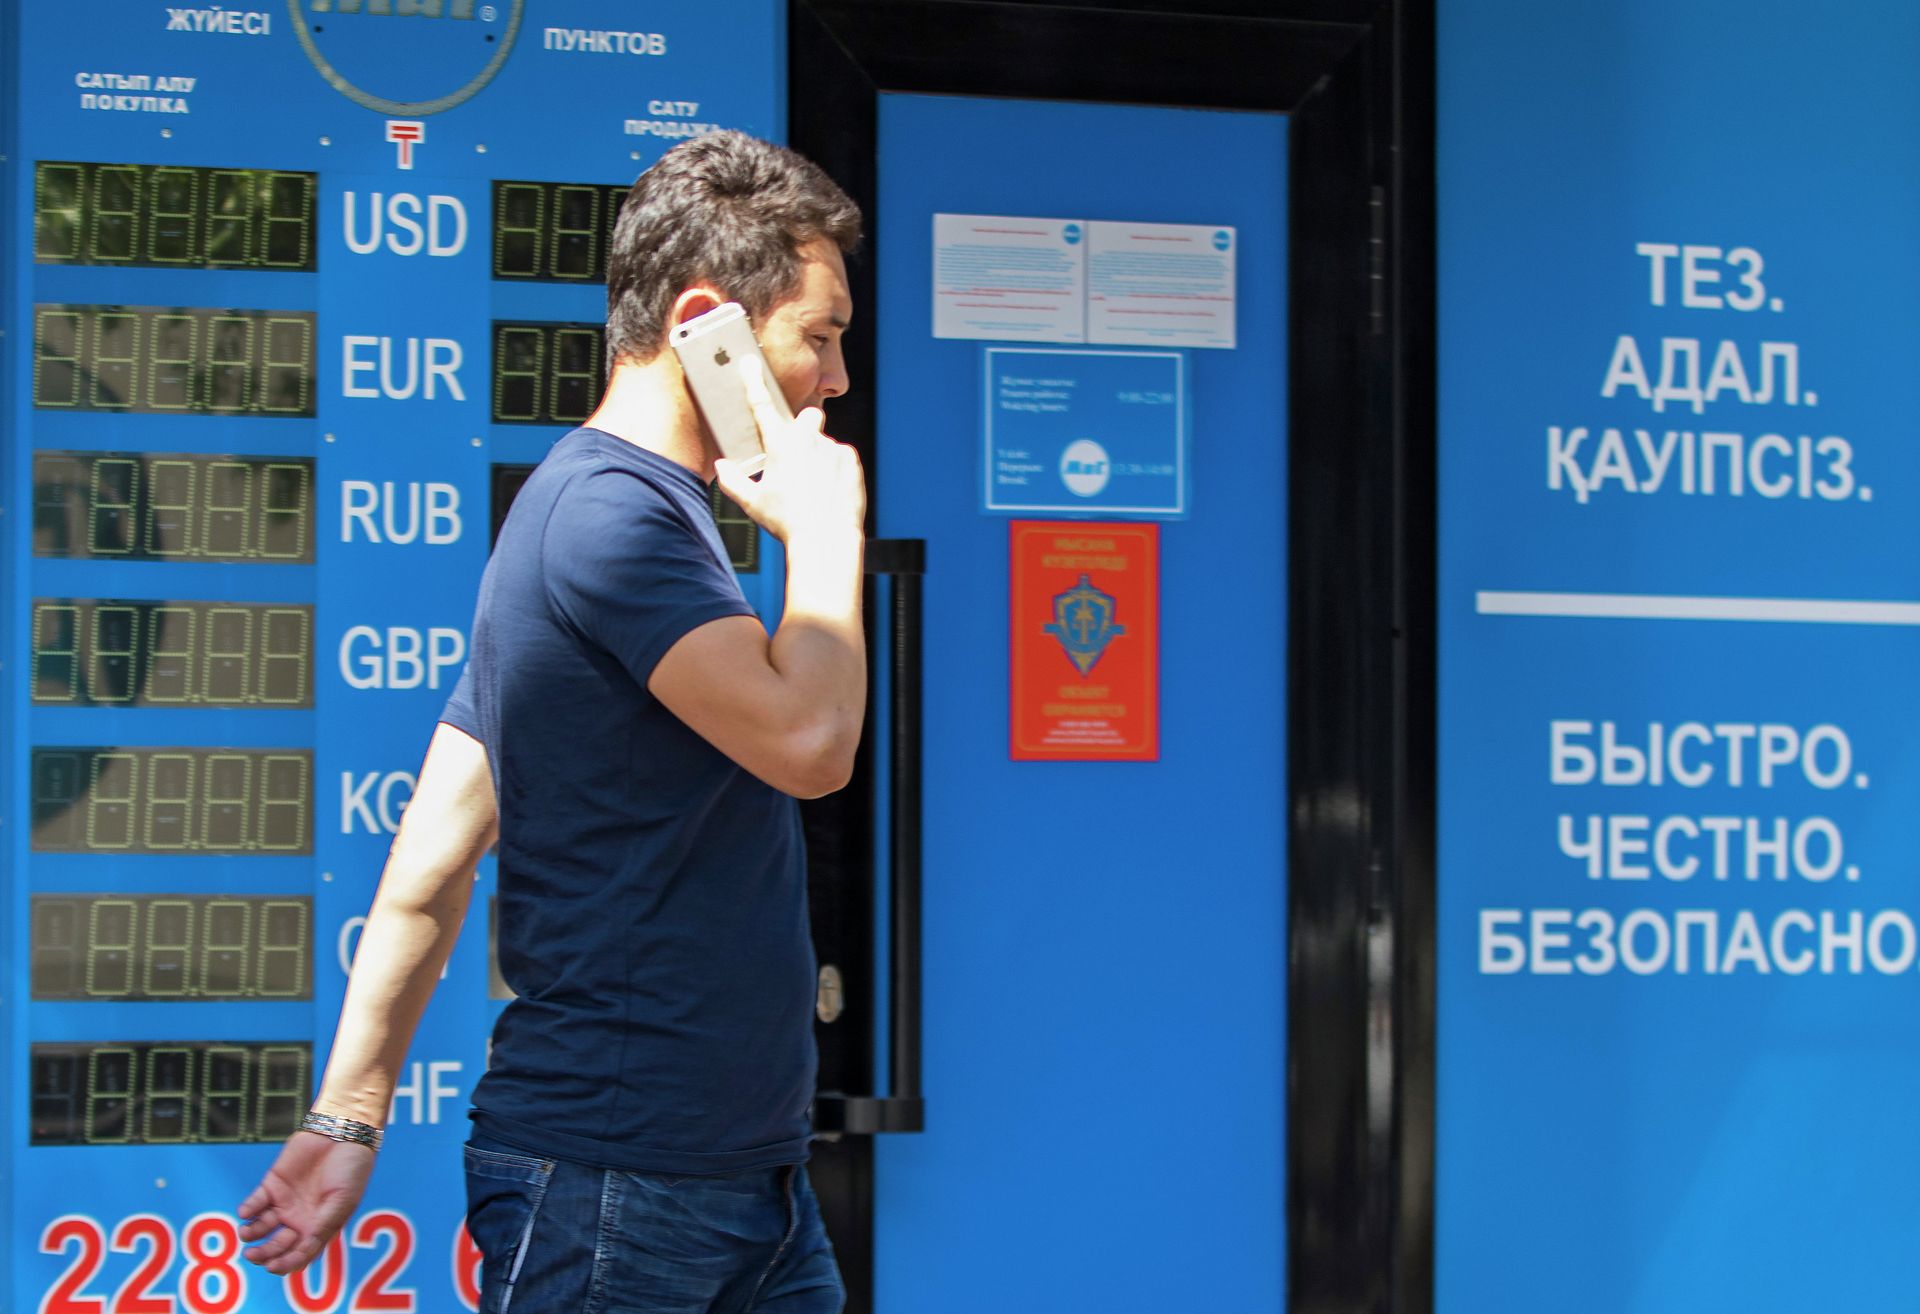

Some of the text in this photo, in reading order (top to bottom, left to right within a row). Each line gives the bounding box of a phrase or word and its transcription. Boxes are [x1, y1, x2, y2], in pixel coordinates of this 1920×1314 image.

[544, 28, 667, 56] ПУНКТОВ
[75, 72, 197, 93] САТЫП АЛУ
[81, 93, 190, 114] ПОКУПКА
[648, 100, 699, 117] САТУ
[344, 191, 467, 257] USD
[1636, 242, 1784, 312] ТЕЗ.
[342, 335, 466, 401] EUR
[1601, 335, 1818, 414] АДАЛ.
[341, 480, 462, 545] RUB
[339, 625, 465, 690] GBP
[1550, 721, 1869, 789] БЫСТРО.
[341, 771, 416, 834] KG
[1558, 815, 1861, 882] ЧЕСТНО.
[1479, 909, 1920, 975] БЕЗОПАСНО
[38, 1212, 247, 1314] 228
[283, 1209, 416, 1314] 02
